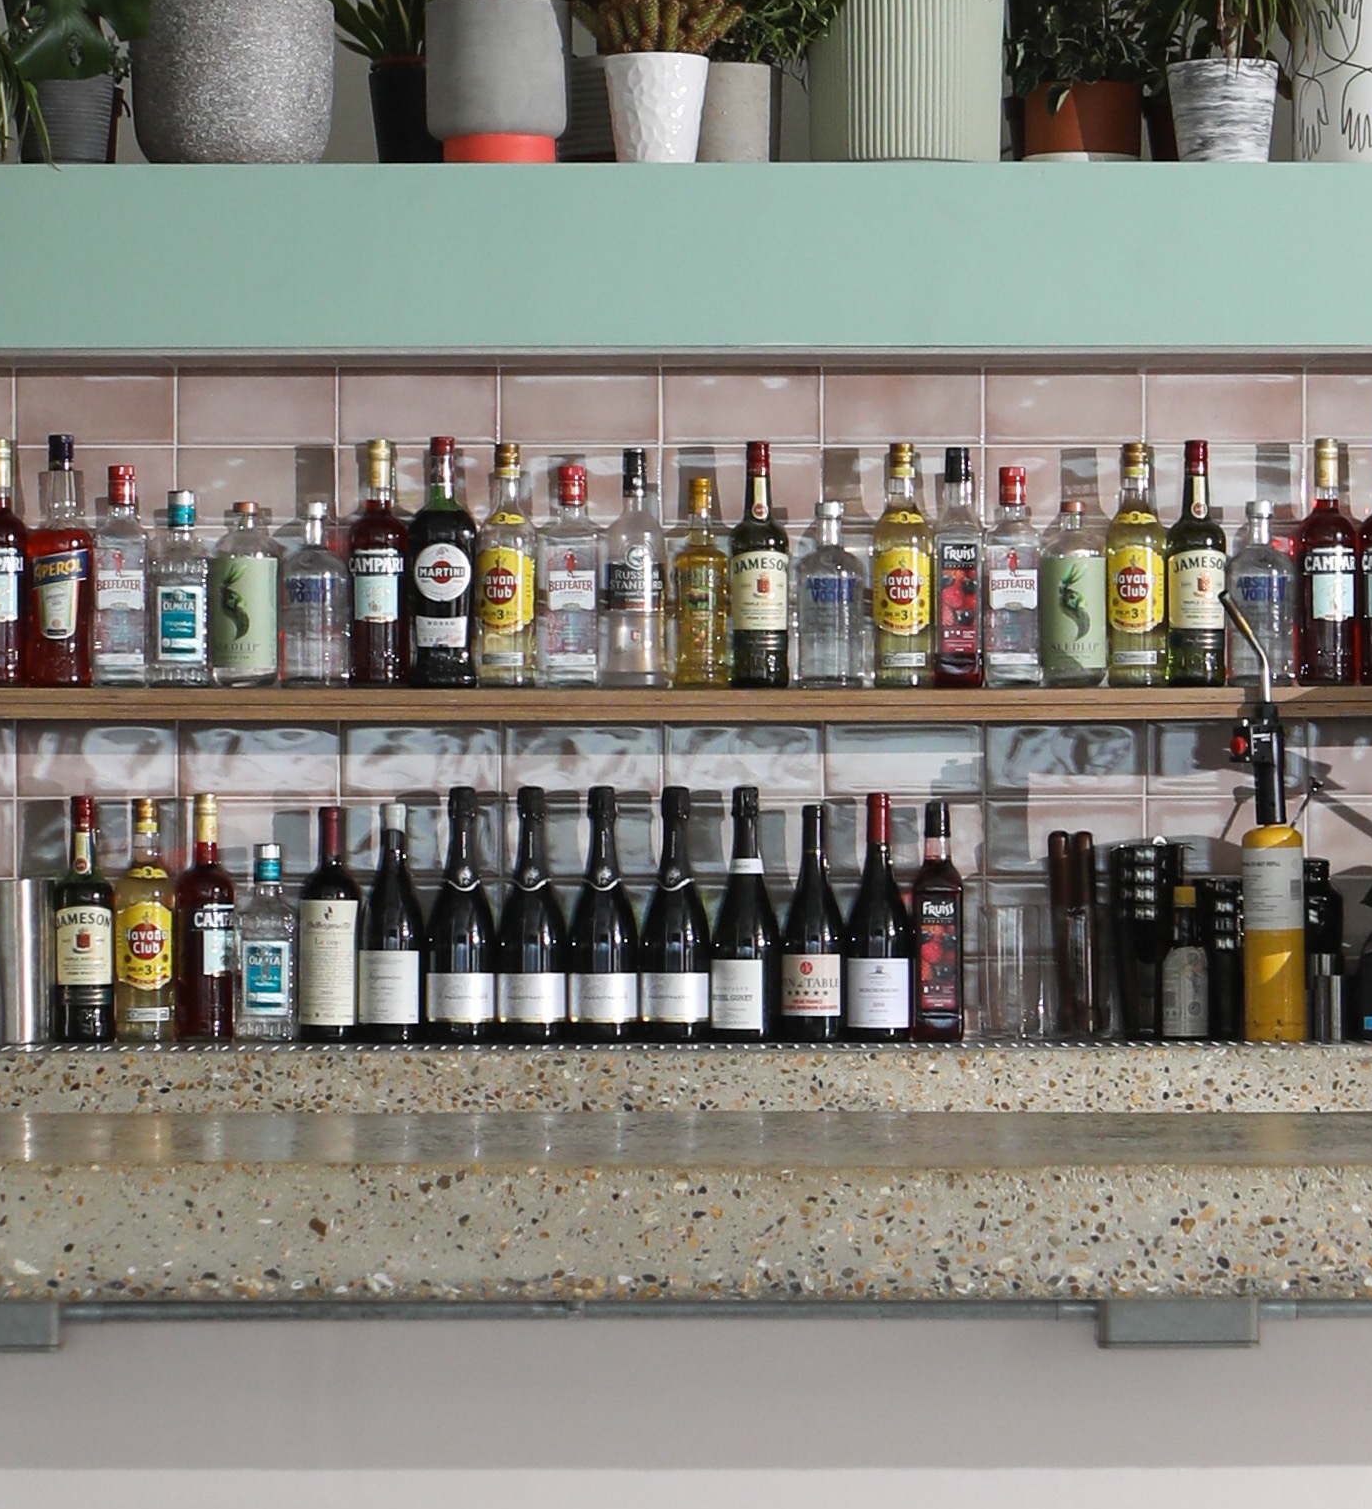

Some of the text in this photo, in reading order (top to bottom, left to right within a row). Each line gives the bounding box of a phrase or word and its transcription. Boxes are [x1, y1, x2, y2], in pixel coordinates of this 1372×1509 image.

[34, 557, 83, 581] APEROL
[349, 557, 404, 573] CAMPARI
[419, 567, 465, 577] MARTINI
[614, 569, 660, 580] RUSSN
[96, 579, 142, 591] BEEFEATER
[548, 580, 593, 592] BEEFEATER
[610, 579, 664, 590] STANDRD
[991, 578, 1036, 592] BEEFEATER
[486, 586, 513, 598] Club
[889, 586, 917, 599] Club
[1119, 585, 1147, 597] Club
[496, 609, 504, 620] 3
[900, 609, 908, 621] 3
[1131, 608, 1139, 619] 3
[56, 911, 112, 929] JAMESON
[193, 911, 232, 929] CAMP
[132, 941, 161, 954] Club
[144, 964, 152, 976] 3
